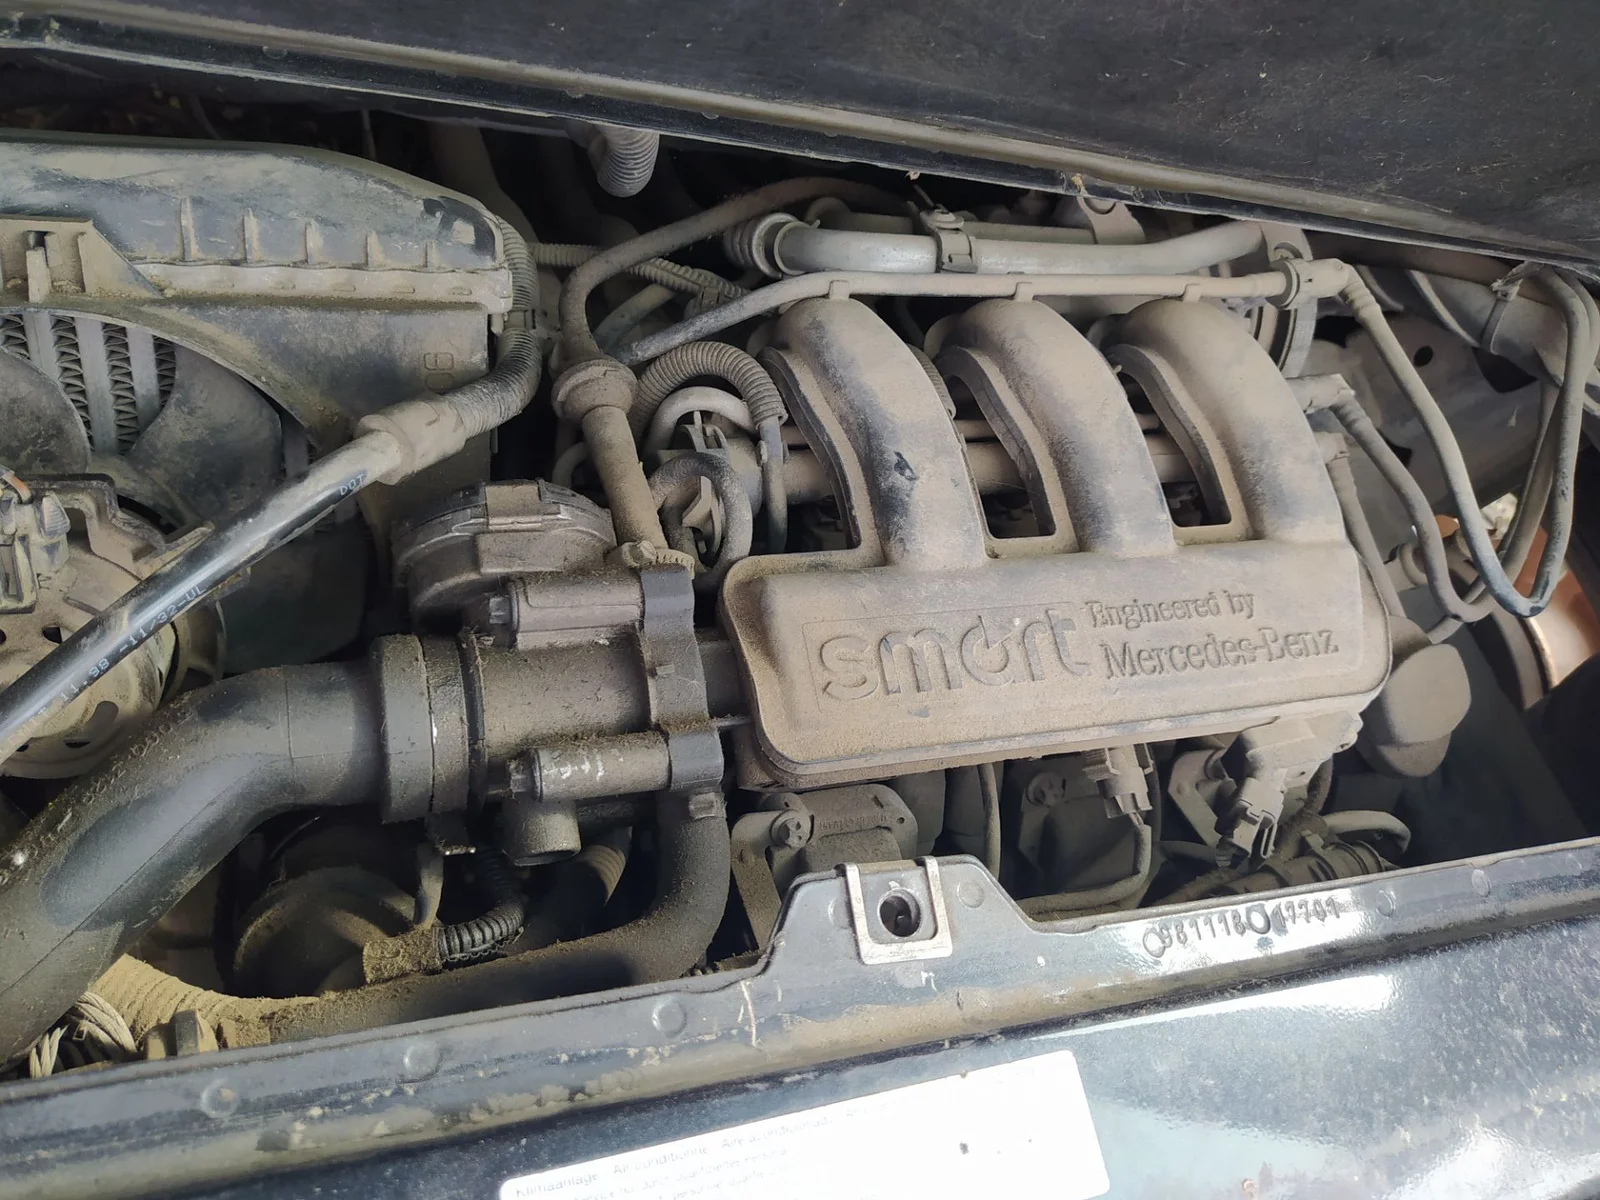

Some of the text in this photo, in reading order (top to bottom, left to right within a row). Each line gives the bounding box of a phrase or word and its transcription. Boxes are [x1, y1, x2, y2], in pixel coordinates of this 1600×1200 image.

[338, 474, 367, 497] DOT
[1084, 590, 1256, 631] Engineered by
[819, 606, 1091, 703] smart
[1097, 627, 1341, 680] Mercedes-Benz
[60, 658, 110, 702] 11.98
